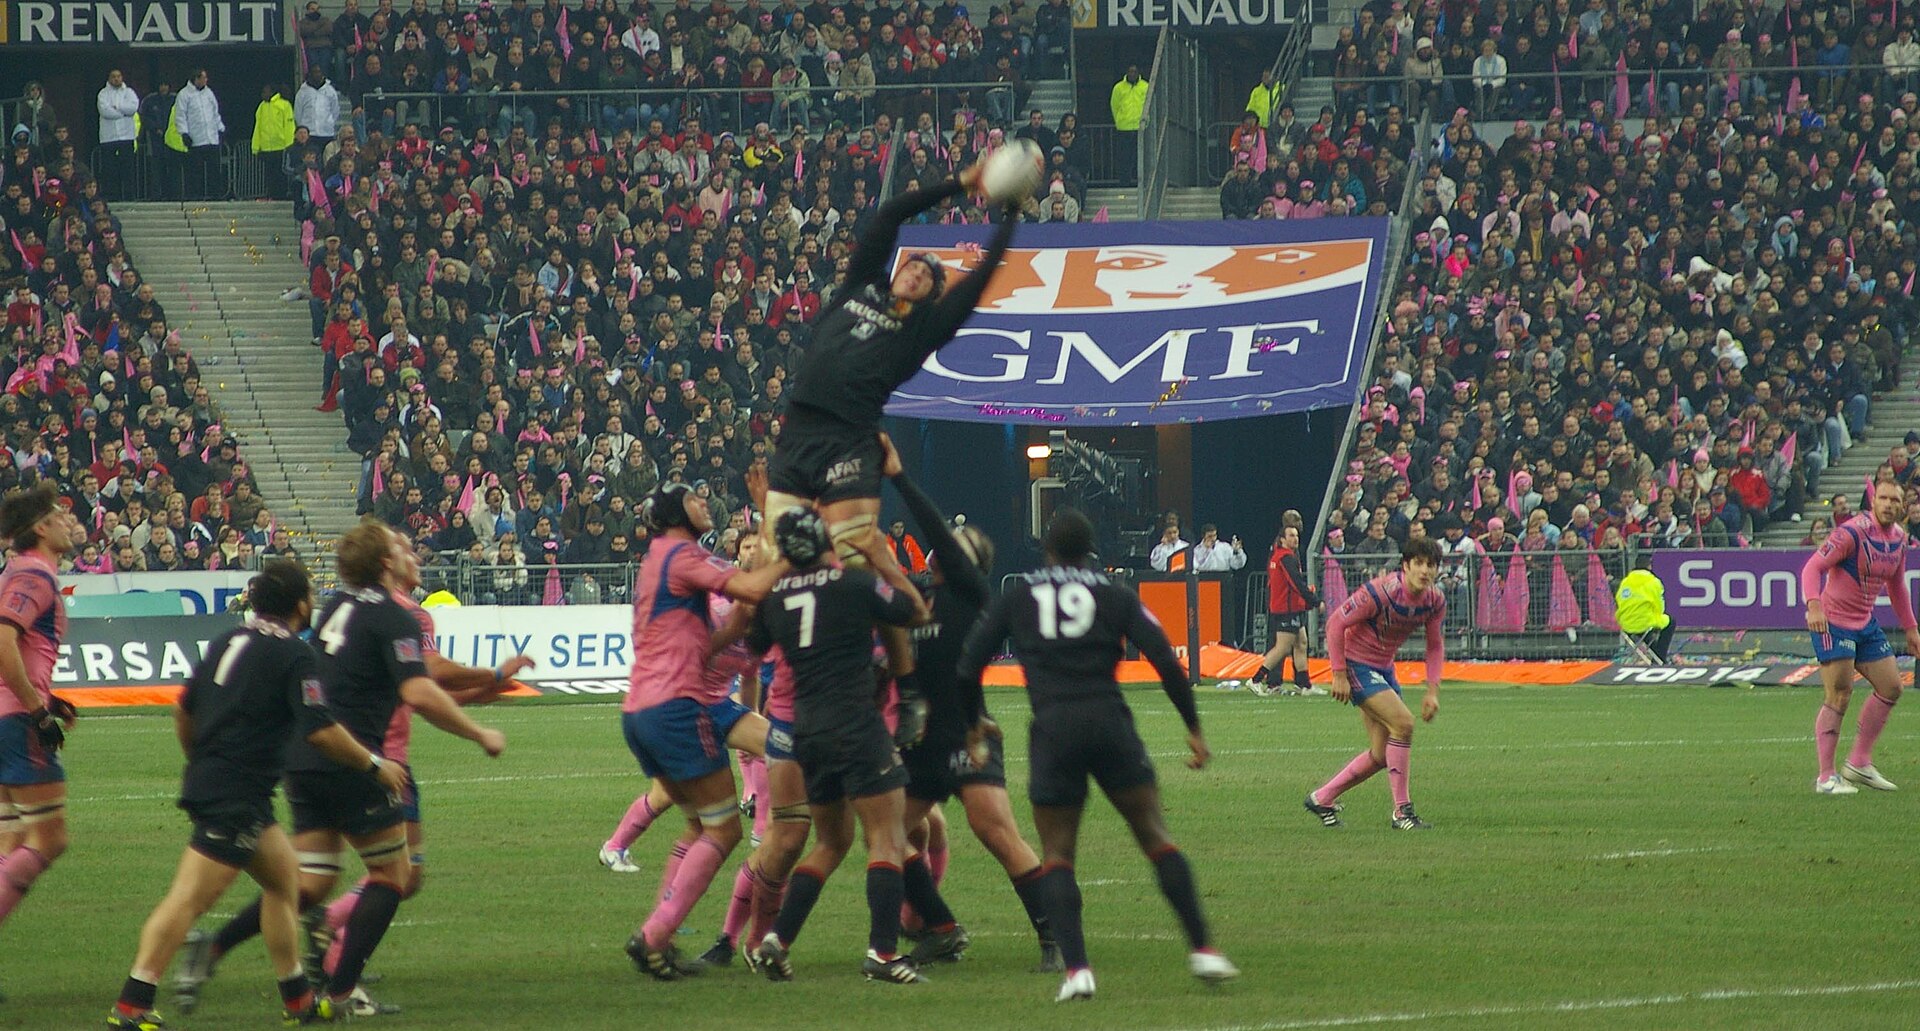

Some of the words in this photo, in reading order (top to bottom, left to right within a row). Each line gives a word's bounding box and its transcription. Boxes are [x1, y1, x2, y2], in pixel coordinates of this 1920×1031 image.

[18, 2, 276, 42] RENAULT
[922, 319, 1319, 384] GMF
[318, 602, 355, 656] 4
[784, 591, 816, 648] 7
[1030, 582, 1097, 639] 19
[51, 640, 209, 682] ERSA
[213, 635, 250, 686] 1
[1613, 667, 1708, 682] TOP
[1709, 666, 1768, 682] 14
